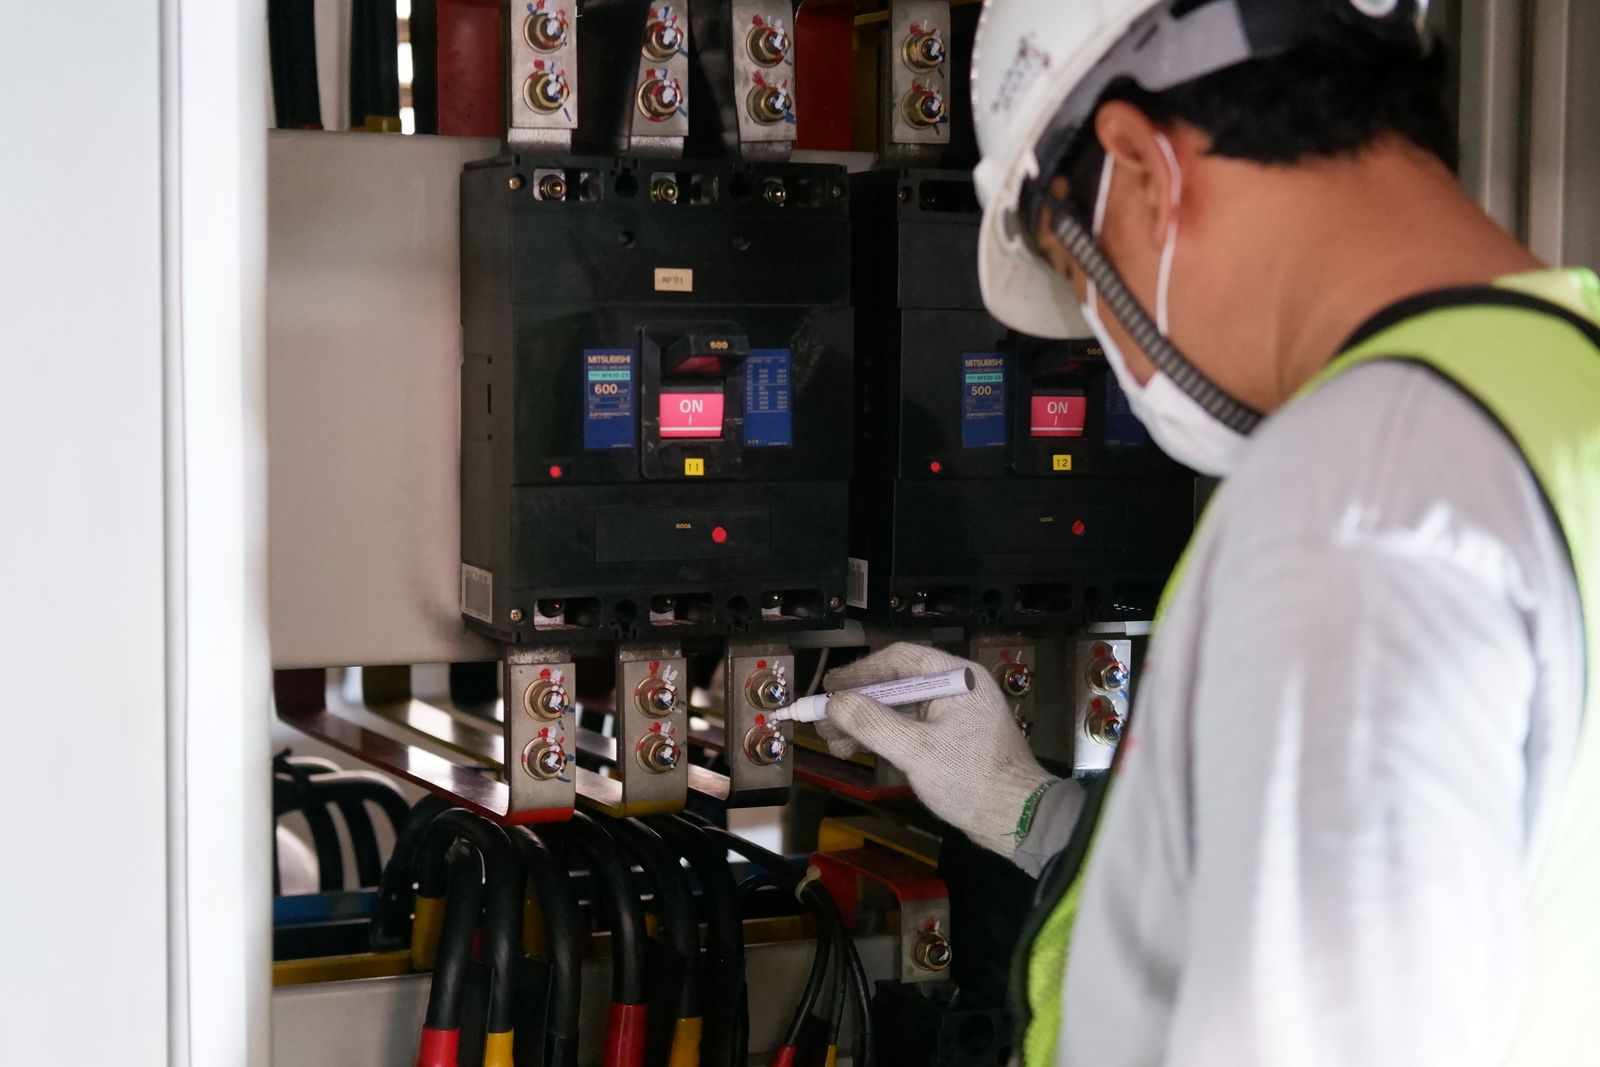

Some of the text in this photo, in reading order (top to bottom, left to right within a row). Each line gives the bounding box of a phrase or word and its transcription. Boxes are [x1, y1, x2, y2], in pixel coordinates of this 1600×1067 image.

[709, 340, 729, 350] 600
[587, 355, 631, 364] MITSUBISHI
[965, 359, 1003, 367] MITSUBISHI
[594, 383, 618, 395] 600
[971, 386, 992, 396] 500
[679, 399, 704, 414] ON
[1047, 401, 1068, 415] ON
[1056, 458, 1068, 468] 12
